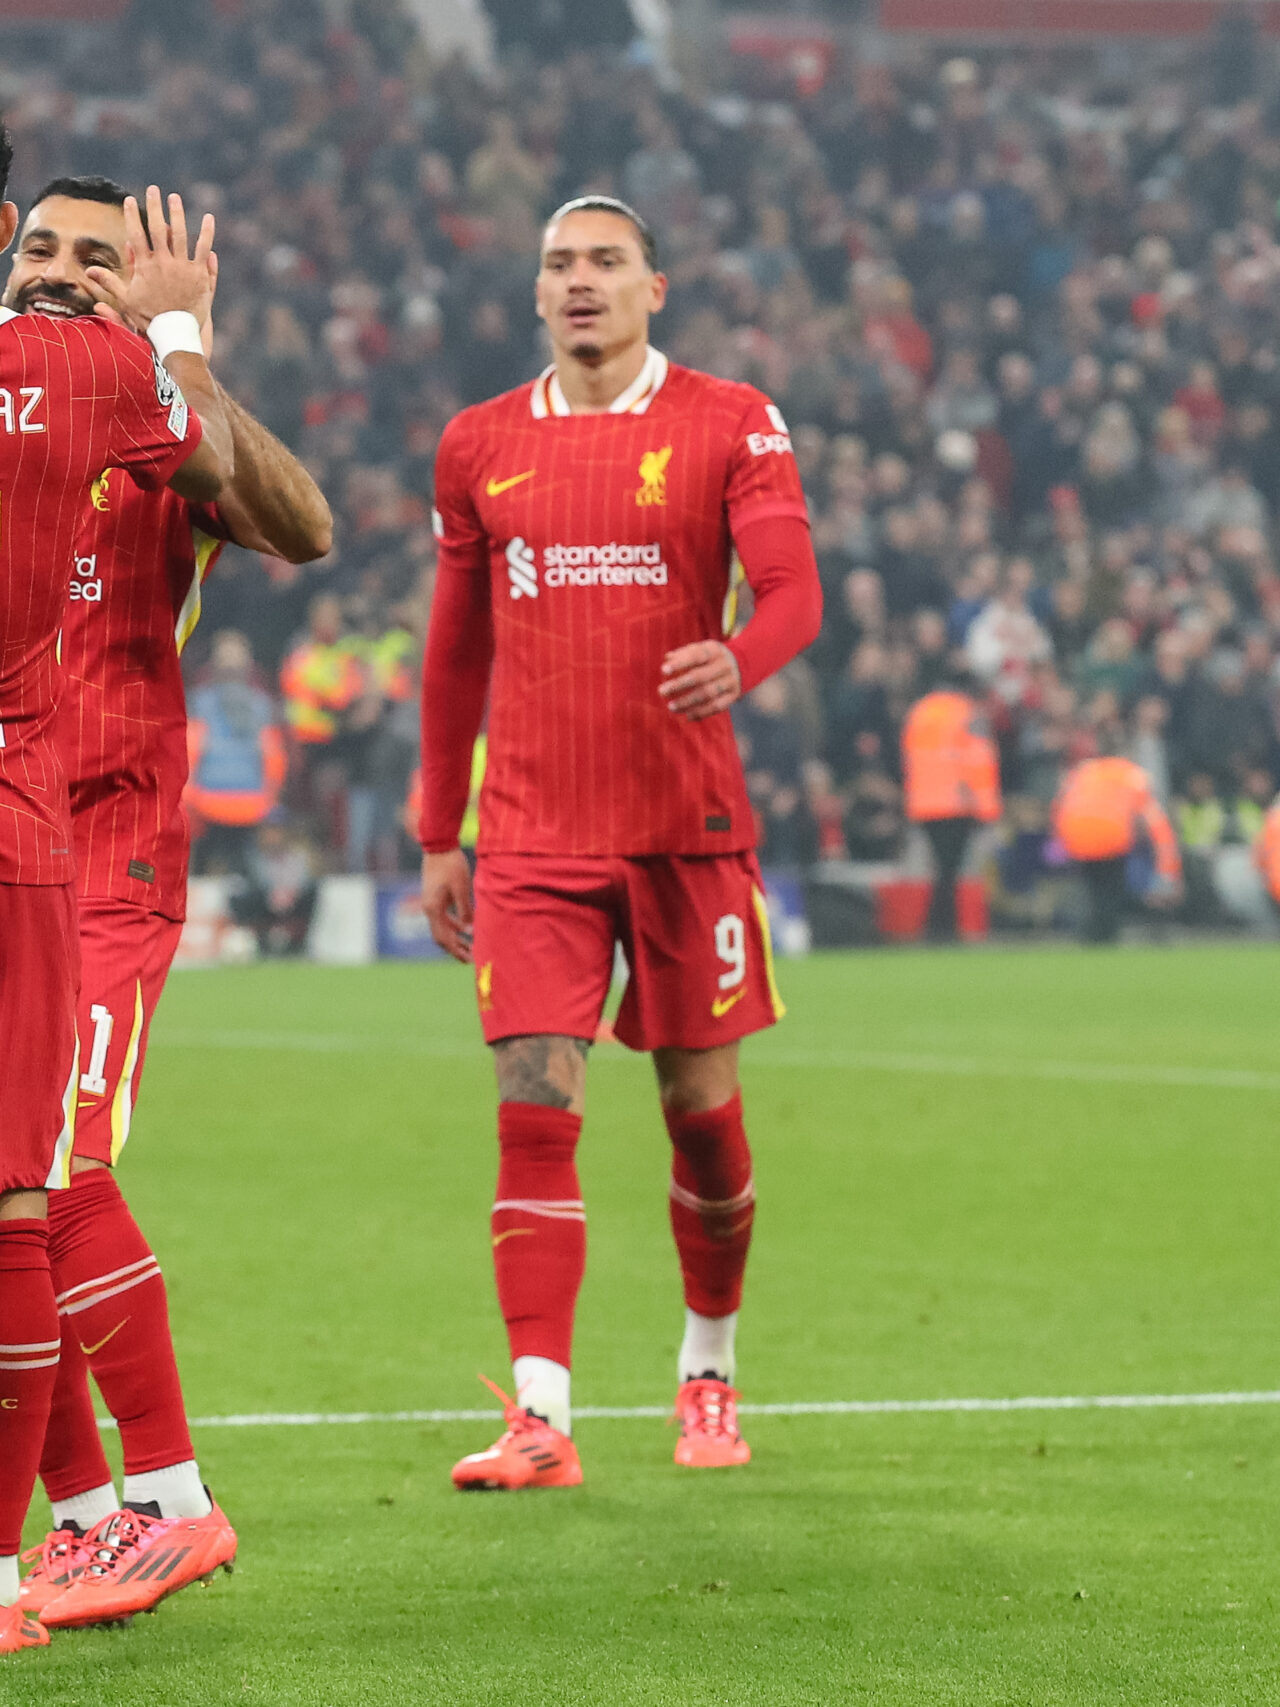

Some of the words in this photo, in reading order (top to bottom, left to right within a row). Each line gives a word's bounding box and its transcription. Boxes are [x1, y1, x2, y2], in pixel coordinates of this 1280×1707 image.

[543, 542, 661, 566] standard
[544, 562, 668, 588] chartered
[714, 913, 746, 990] 9
